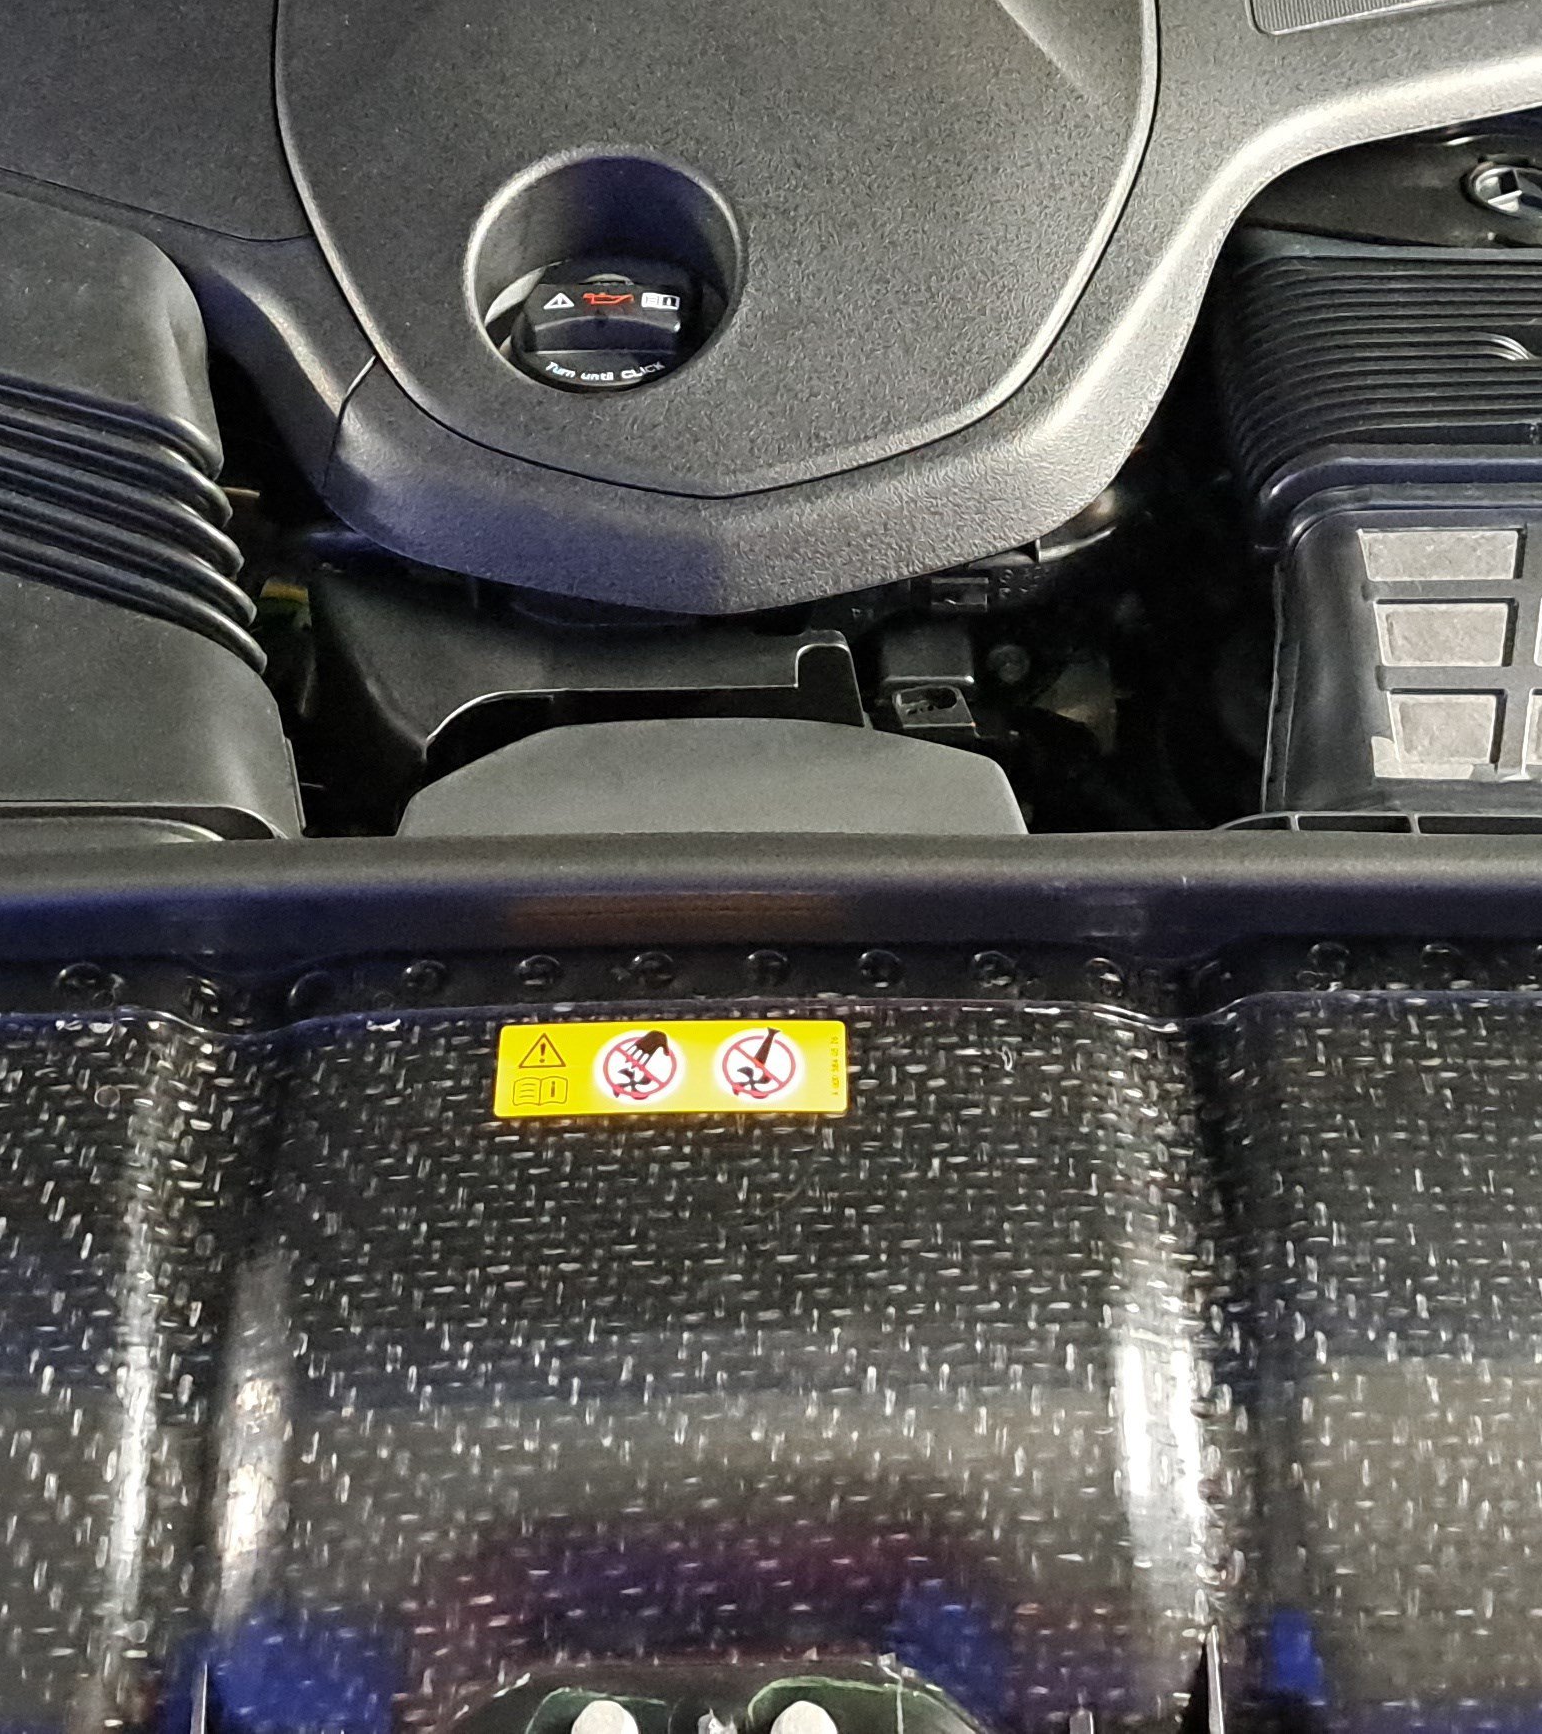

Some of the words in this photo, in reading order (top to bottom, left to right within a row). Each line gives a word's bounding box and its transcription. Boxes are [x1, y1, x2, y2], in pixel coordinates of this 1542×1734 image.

[545, 361, 576, 378] Turn
[581, 372, 613, 380] until
[621, 361, 665, 378] CLICK
